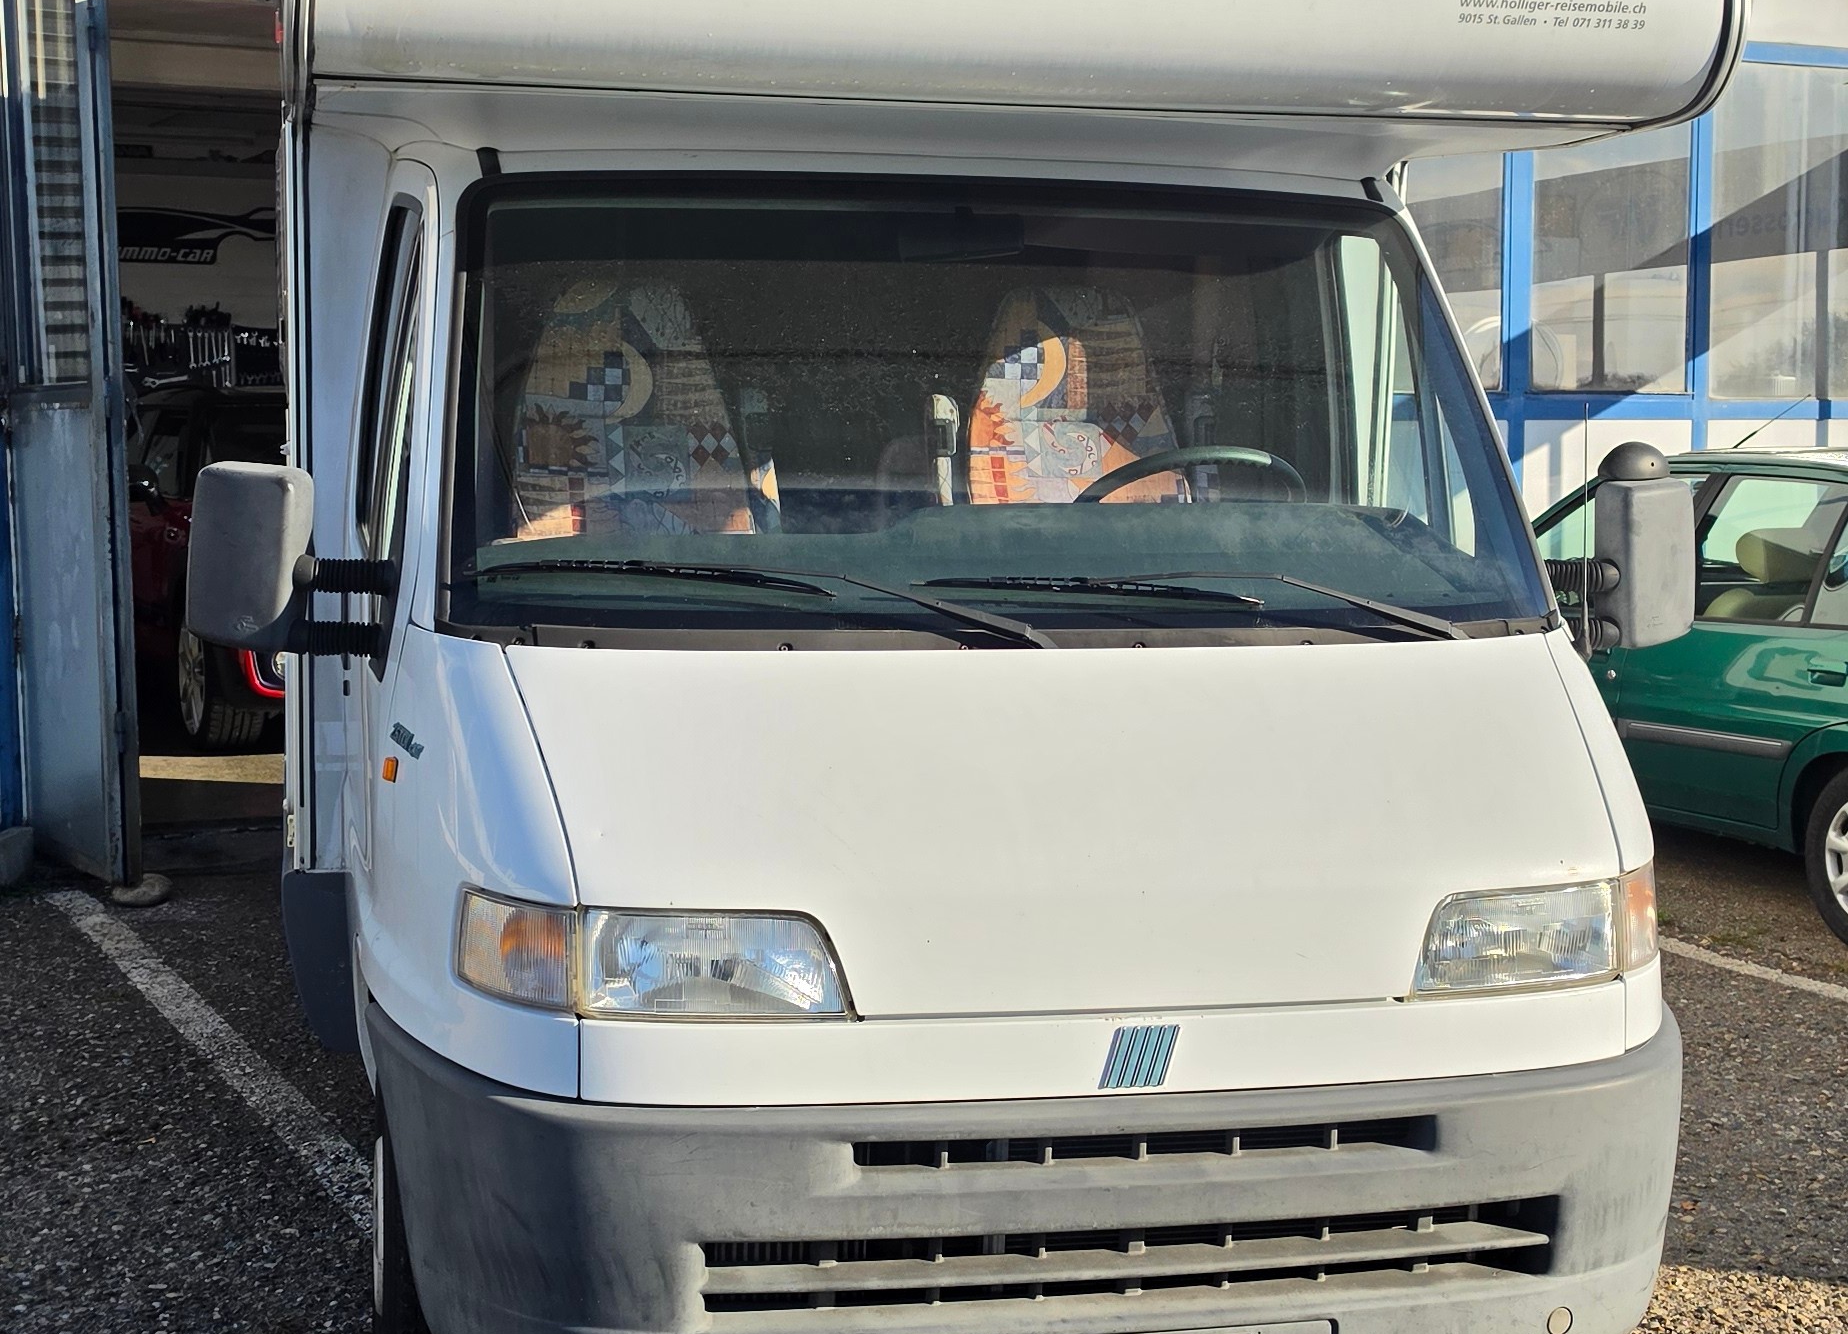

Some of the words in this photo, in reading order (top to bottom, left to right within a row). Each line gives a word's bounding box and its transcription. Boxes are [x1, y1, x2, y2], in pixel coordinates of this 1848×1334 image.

[1458, 12, 1484, 24] 9015
[1486, 13, 1500, 25] St.
[1502, 14, 1537, 26] Gallen
[1553, 16, 1569, 28] Tel
[1572, 17, 1591, 28] 071
[1594, 18, 1612, 29] 311
[1615, 18, 1629, 30] 38
[1631, 19, 1646, 30] 39
